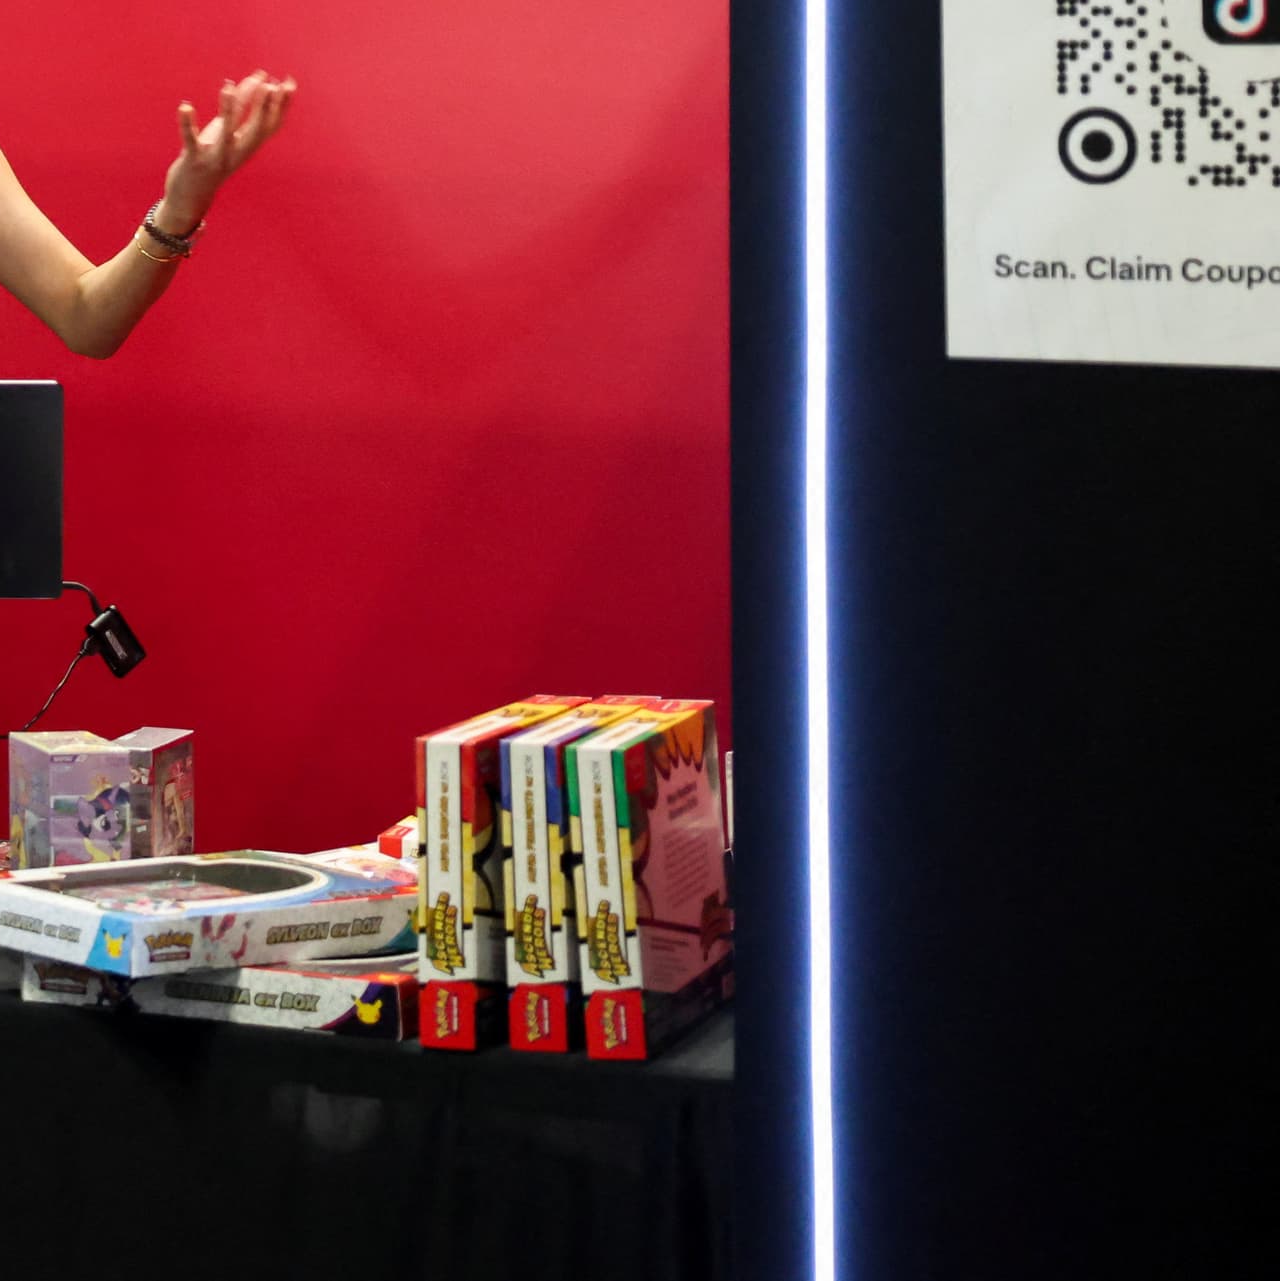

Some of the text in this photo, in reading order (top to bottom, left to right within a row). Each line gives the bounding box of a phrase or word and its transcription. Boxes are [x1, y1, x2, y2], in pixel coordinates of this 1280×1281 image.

[994, 253, 1280, 290] Scan. Claim Coupo
[351, 916, 383, 935] BOX
[280, 991, 320, 1013] BOX
